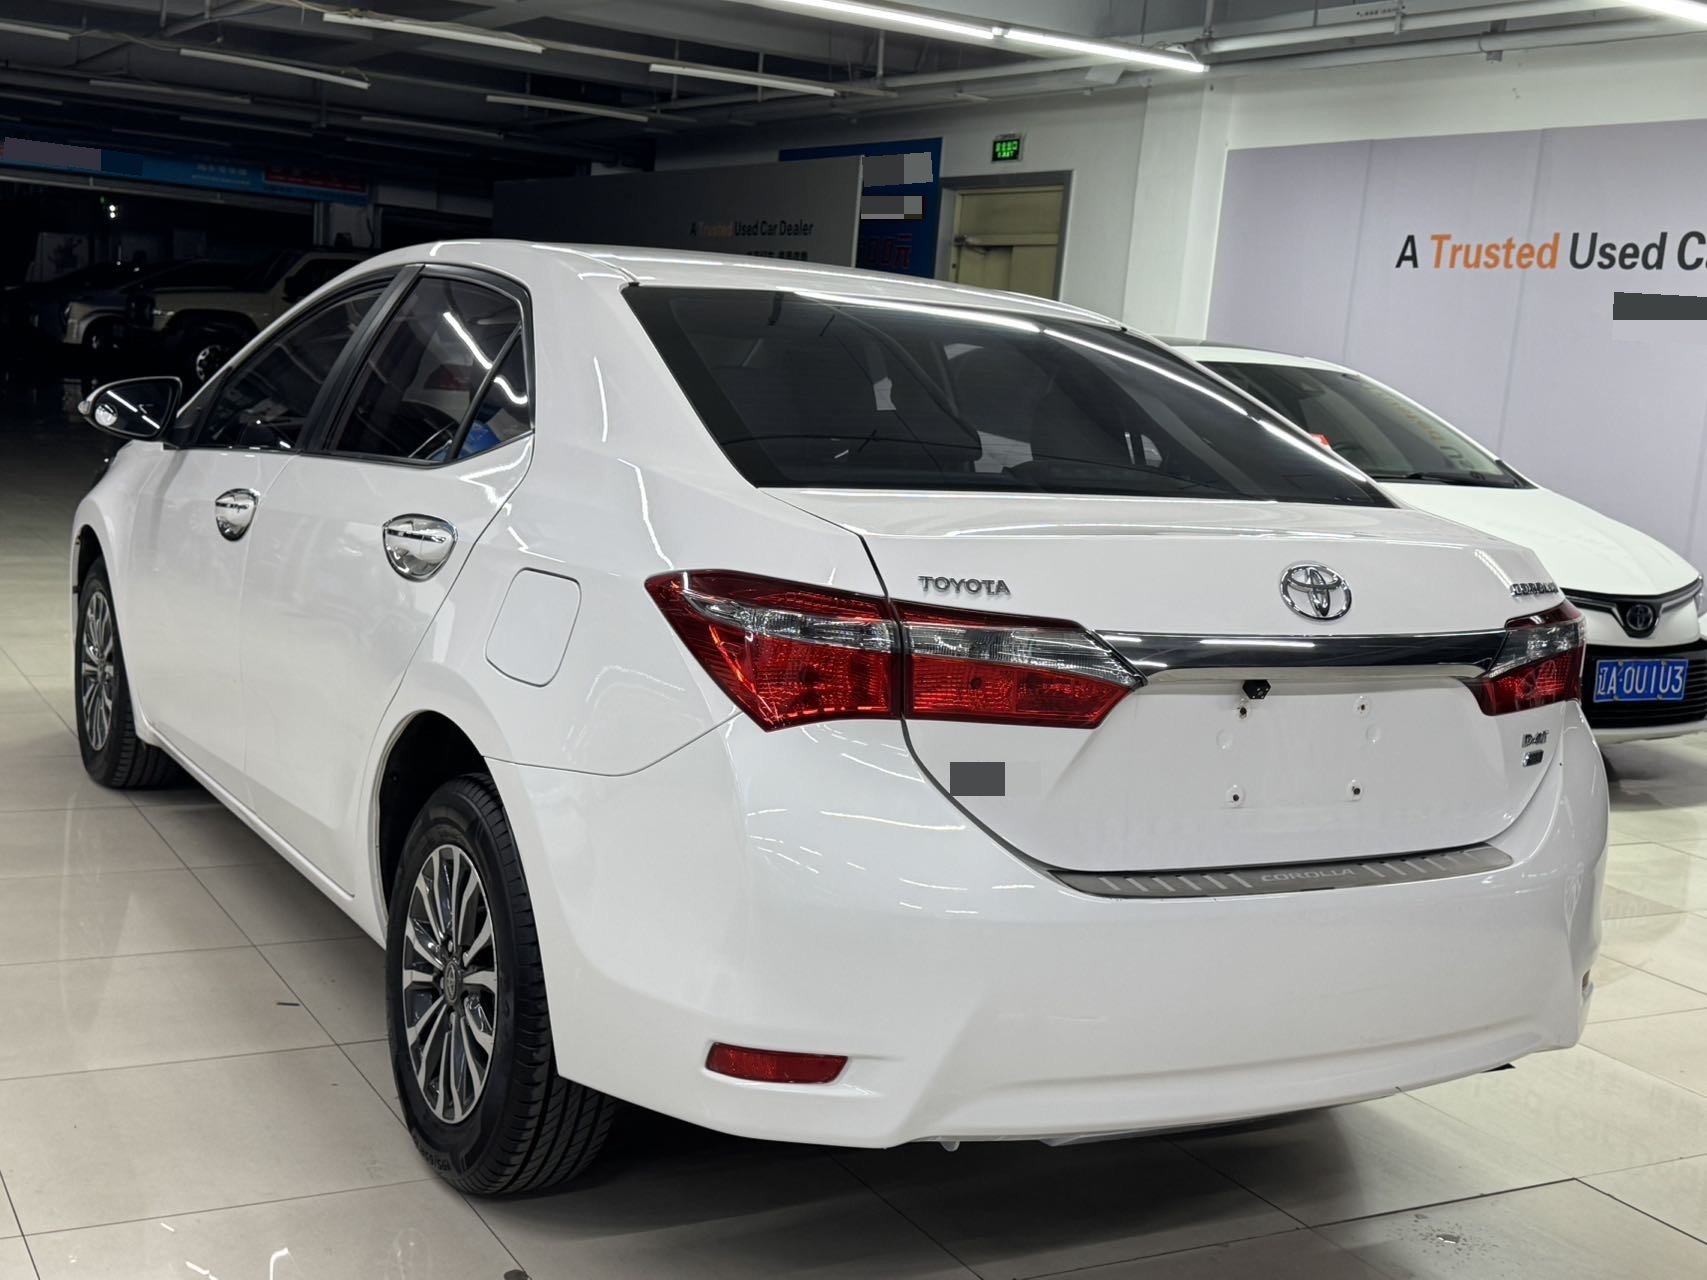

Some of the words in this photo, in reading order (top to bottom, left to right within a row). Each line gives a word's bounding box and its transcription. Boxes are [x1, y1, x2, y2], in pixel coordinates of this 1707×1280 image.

[735, 220, 759, 236] Used
[760, 220, 778, 236] Car
[779, 219, 814, 236] Dealer
[1395, 234, 1419, 269] A
[1430, 232, 1561, 270] Trusted
[1569, 231, 1668, 270] Used
[1677, 230, 1707, 271] C
[918, 576, 1011, 596] TOYOTA
[1261, 868, 1356, 881] COROLLA
